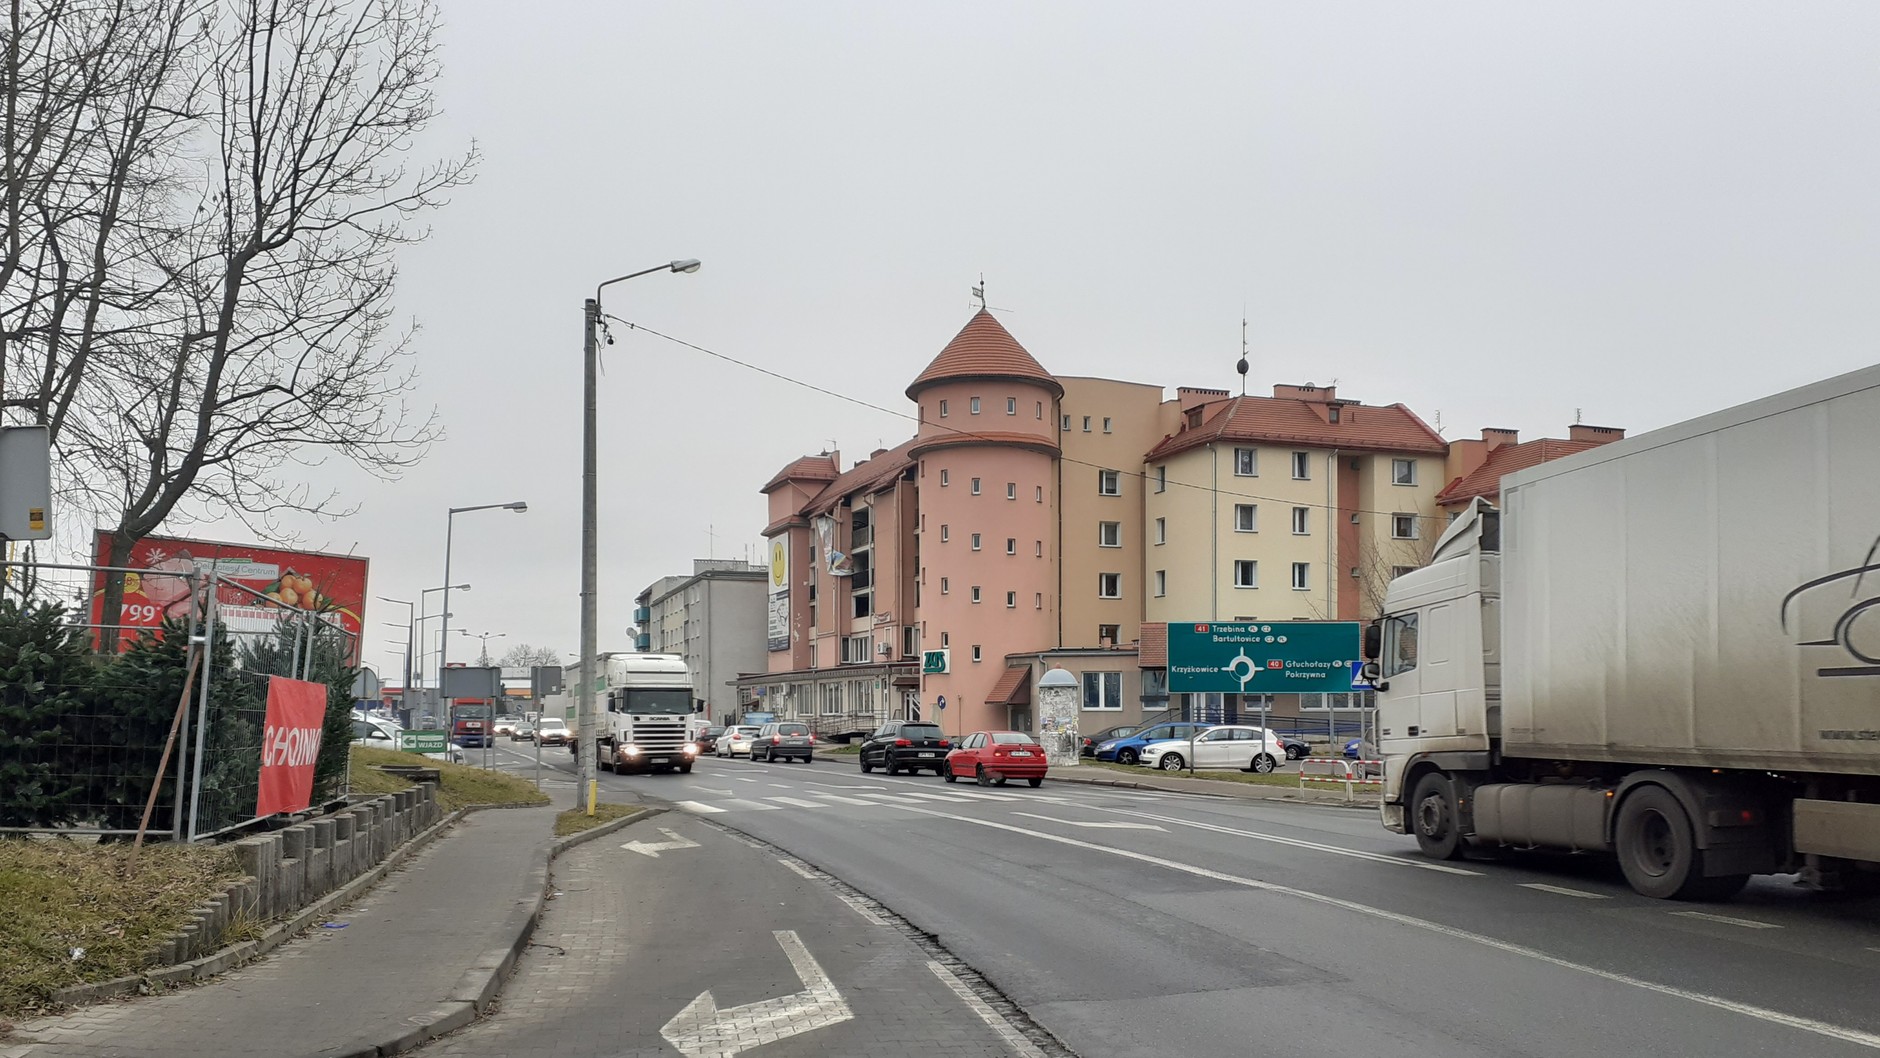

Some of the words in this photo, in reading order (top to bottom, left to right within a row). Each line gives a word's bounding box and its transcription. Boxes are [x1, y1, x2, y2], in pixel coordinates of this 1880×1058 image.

[241, 565, 276, 575] Centrum
[1197, 624, 1206, 632] 41
[1212, 625, 1246, 633] Trzebina
[1212, 635, 1261, 643] Bartultovice
[1285, 660, 1331, 669] Głuchołazy
[1171, 665, 1219, 674] Krzyżkowice
[1285, 671, 1326, 679] Pokrzywna
